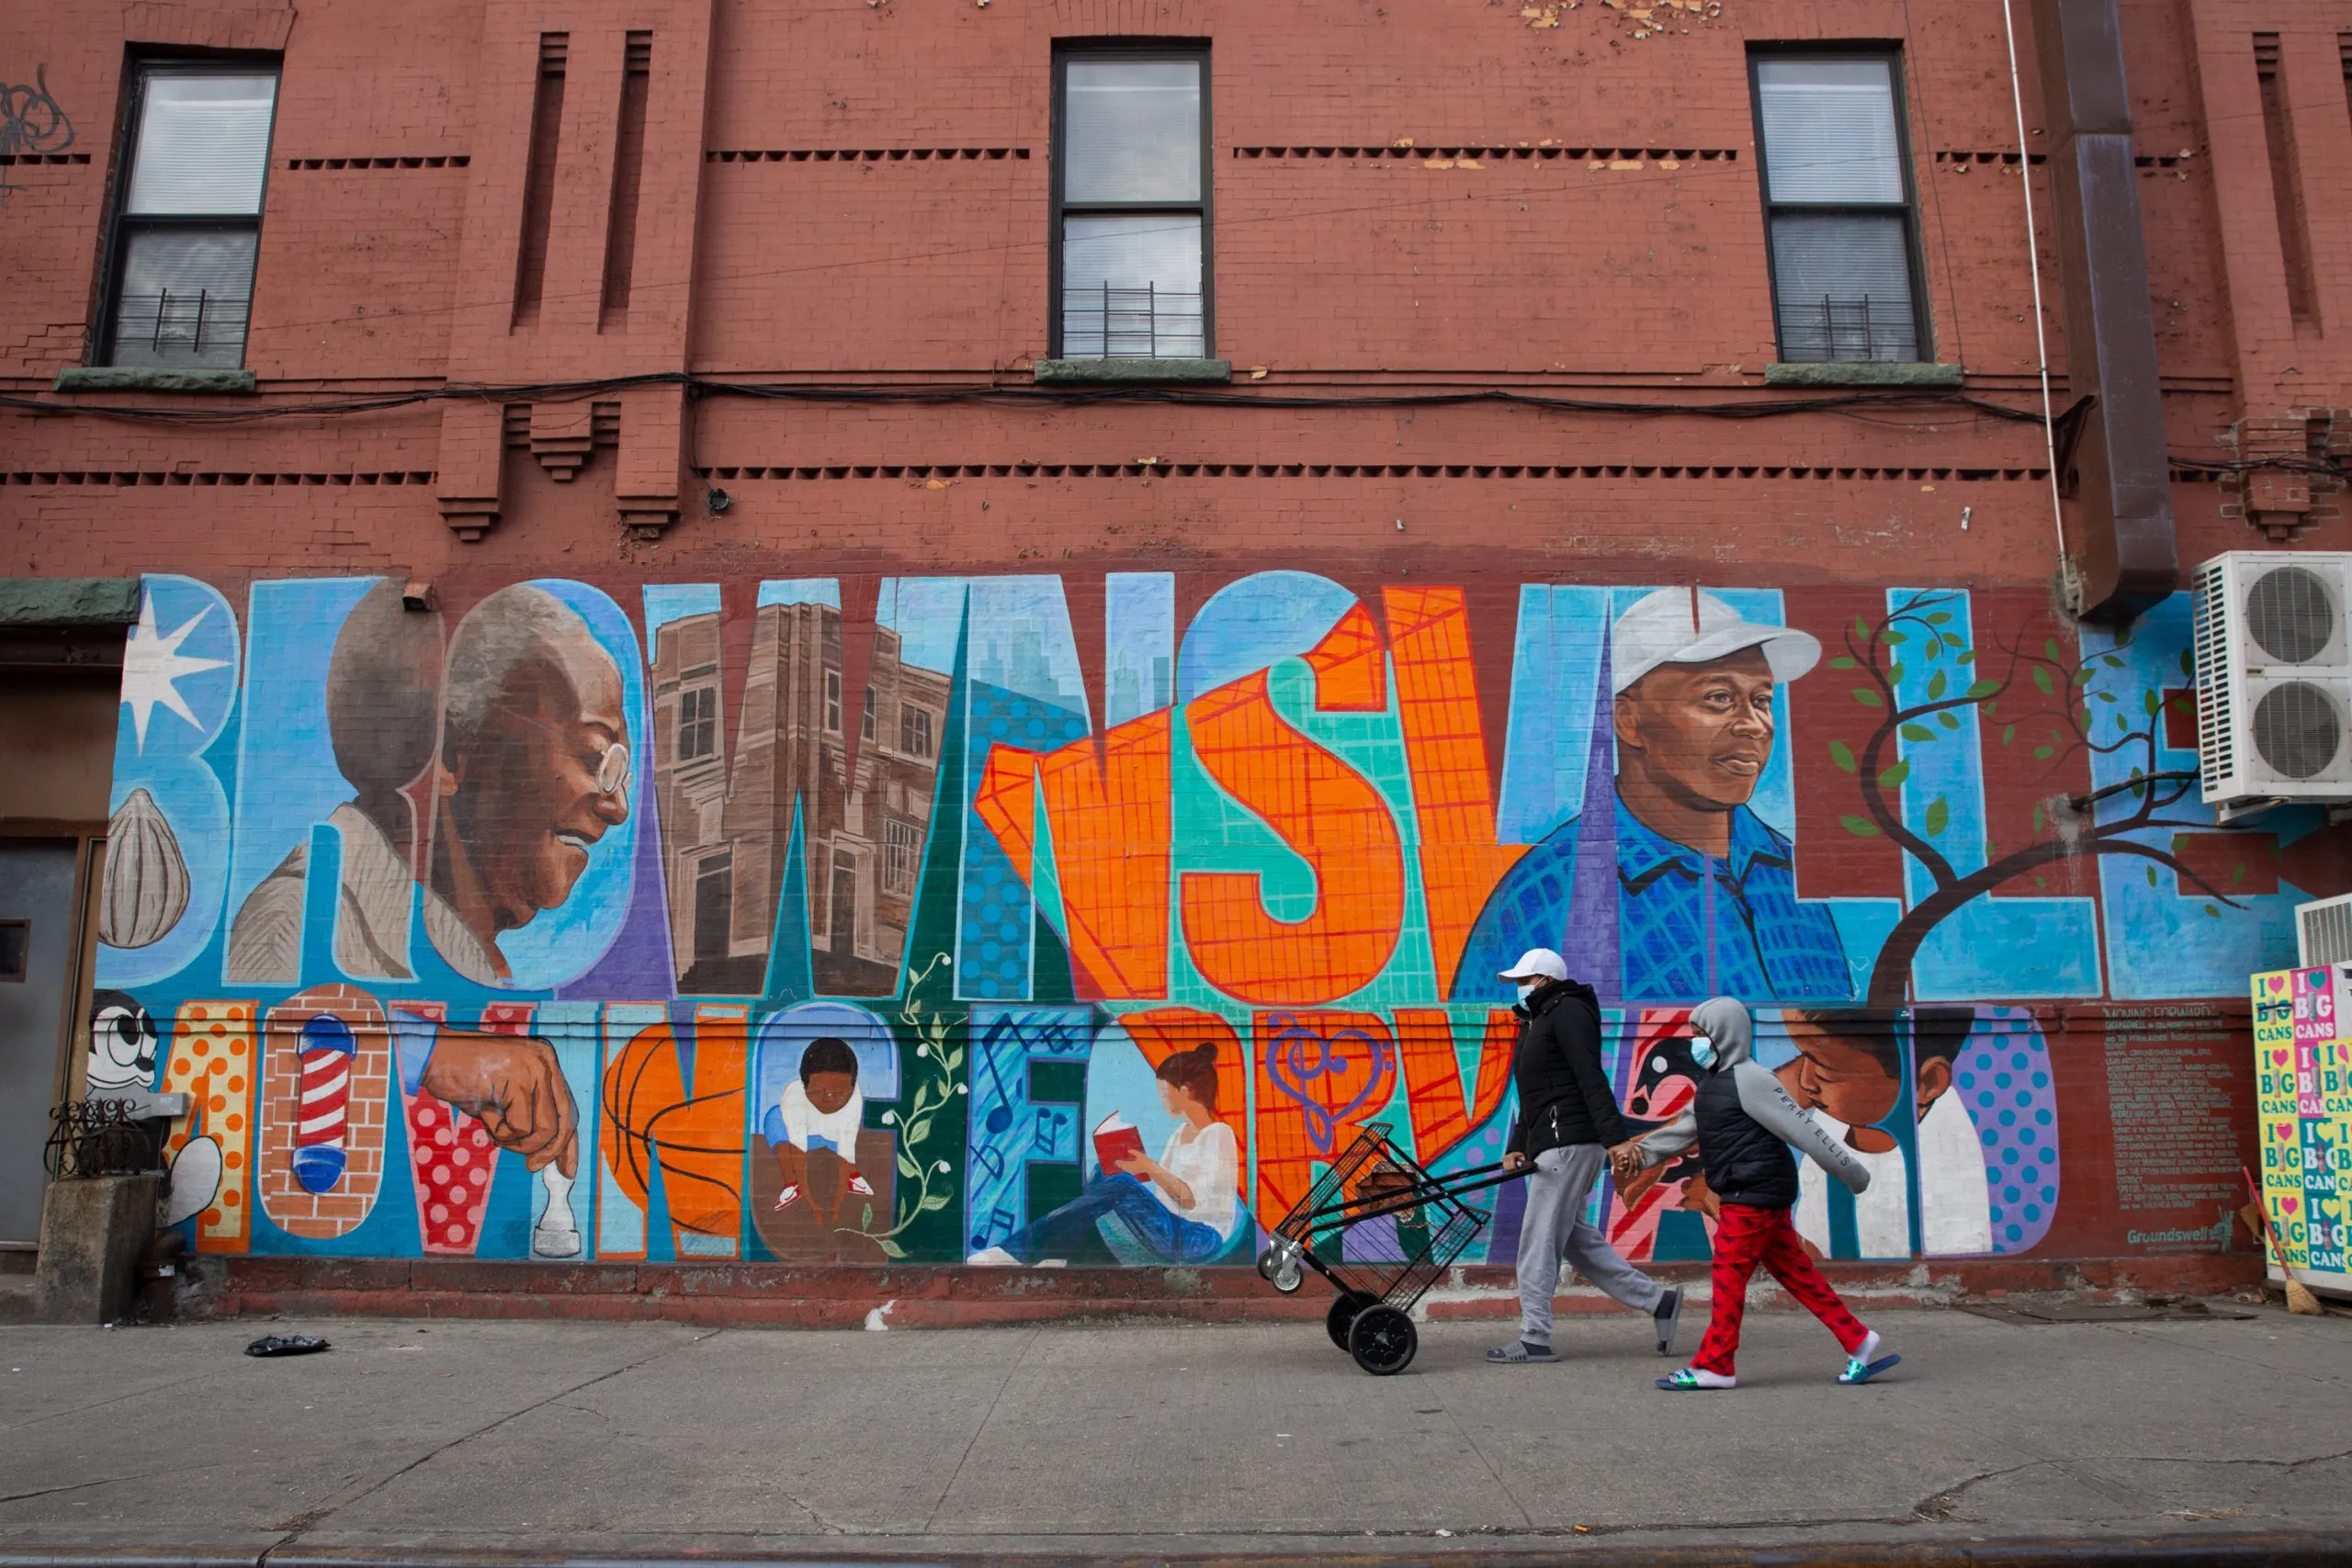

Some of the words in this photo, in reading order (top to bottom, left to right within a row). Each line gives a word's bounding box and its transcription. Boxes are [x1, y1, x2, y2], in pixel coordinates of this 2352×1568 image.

[94, 570, 2315, 1002] BROWNSVILLE
[2258, 978, 2266, 998] I
[2298, 973, 2306, 994] I
[2257, 1026, 2292, 1042] CANS
[2295, 1022, 2334, 1039] CANS
[2264, 1050, 2270, 1069] I
[2301, 1047, 2310, 1068] I
[2326, 1045, 2335, 1066] I
[2298, 1066, 2322, 1098] BI
[2262, 1100, 2297, 1114] CANS
[2300, 1099, 2323, 1114] CA
[2325, 1098, 2352, 1112] CAN
[86, 982, 902, 1265] MOVING
[1773, 1087, 1814, 1126] PERRY
[1815, 1129, 1850, 1168] ELLIS
[2267, 1123, 2275, 1143] I
[2305, 1122, 2314, 1143] I
[2340, 1122, 2348, 1144] I
[2266, 1175, 2302, 1189] CANS
[2304, 1175, 2335, 1190] CAN
[2272, 1197, 2279, 1216] I
[2311, 1198, 2321, 1219] I
[2128, 1227, 2208, 1244] Groundswell
